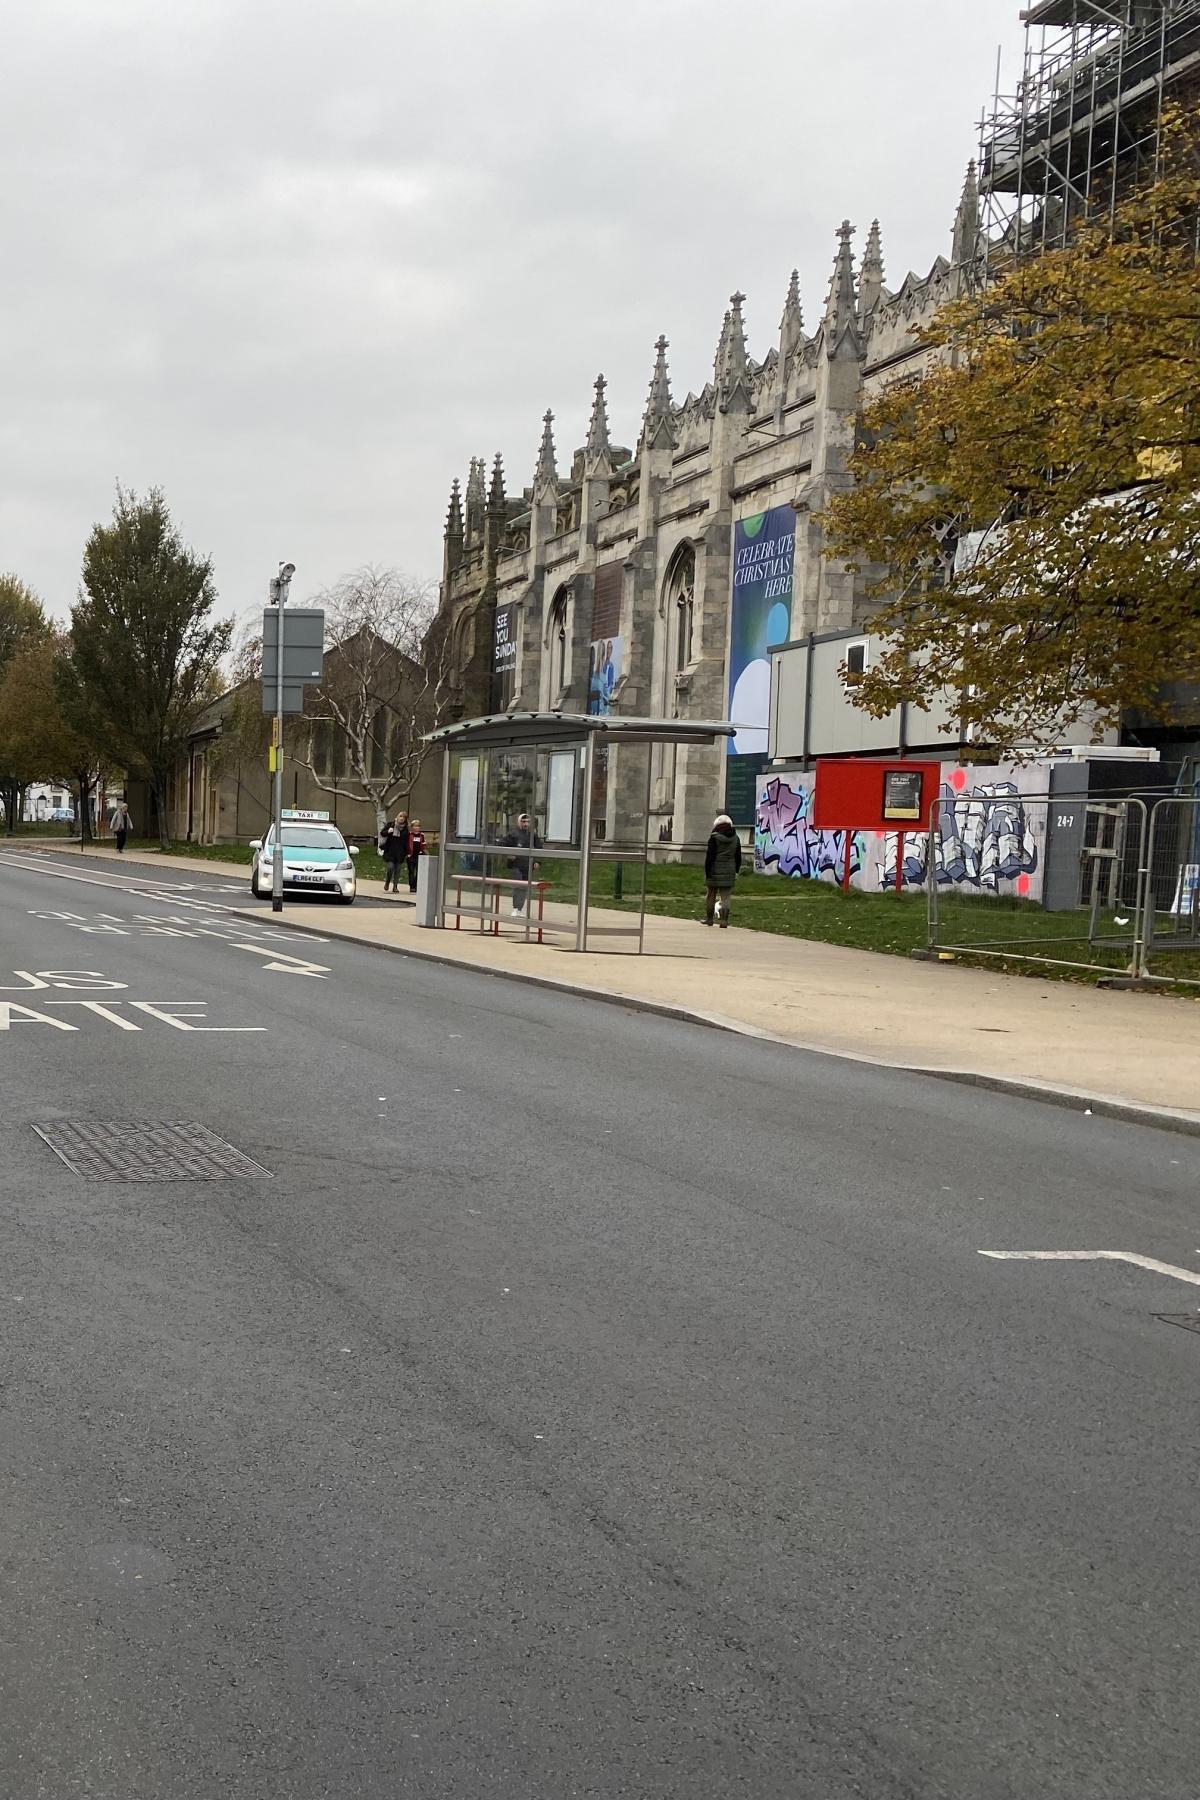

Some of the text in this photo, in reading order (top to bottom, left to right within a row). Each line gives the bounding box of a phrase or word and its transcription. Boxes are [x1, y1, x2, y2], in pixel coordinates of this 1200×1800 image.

[737, 533, 795, 566] CELEBRATE
[734, 555, 791, 587] CHRISTMAS
[765, 574, 794, 599] HERE
[496, 613, 508, 629] SEE
[496, 628, 509, 644] YOU
[1057, 815, 1074, 828] 24-7
[66, 923, 330, 942] OTHER
